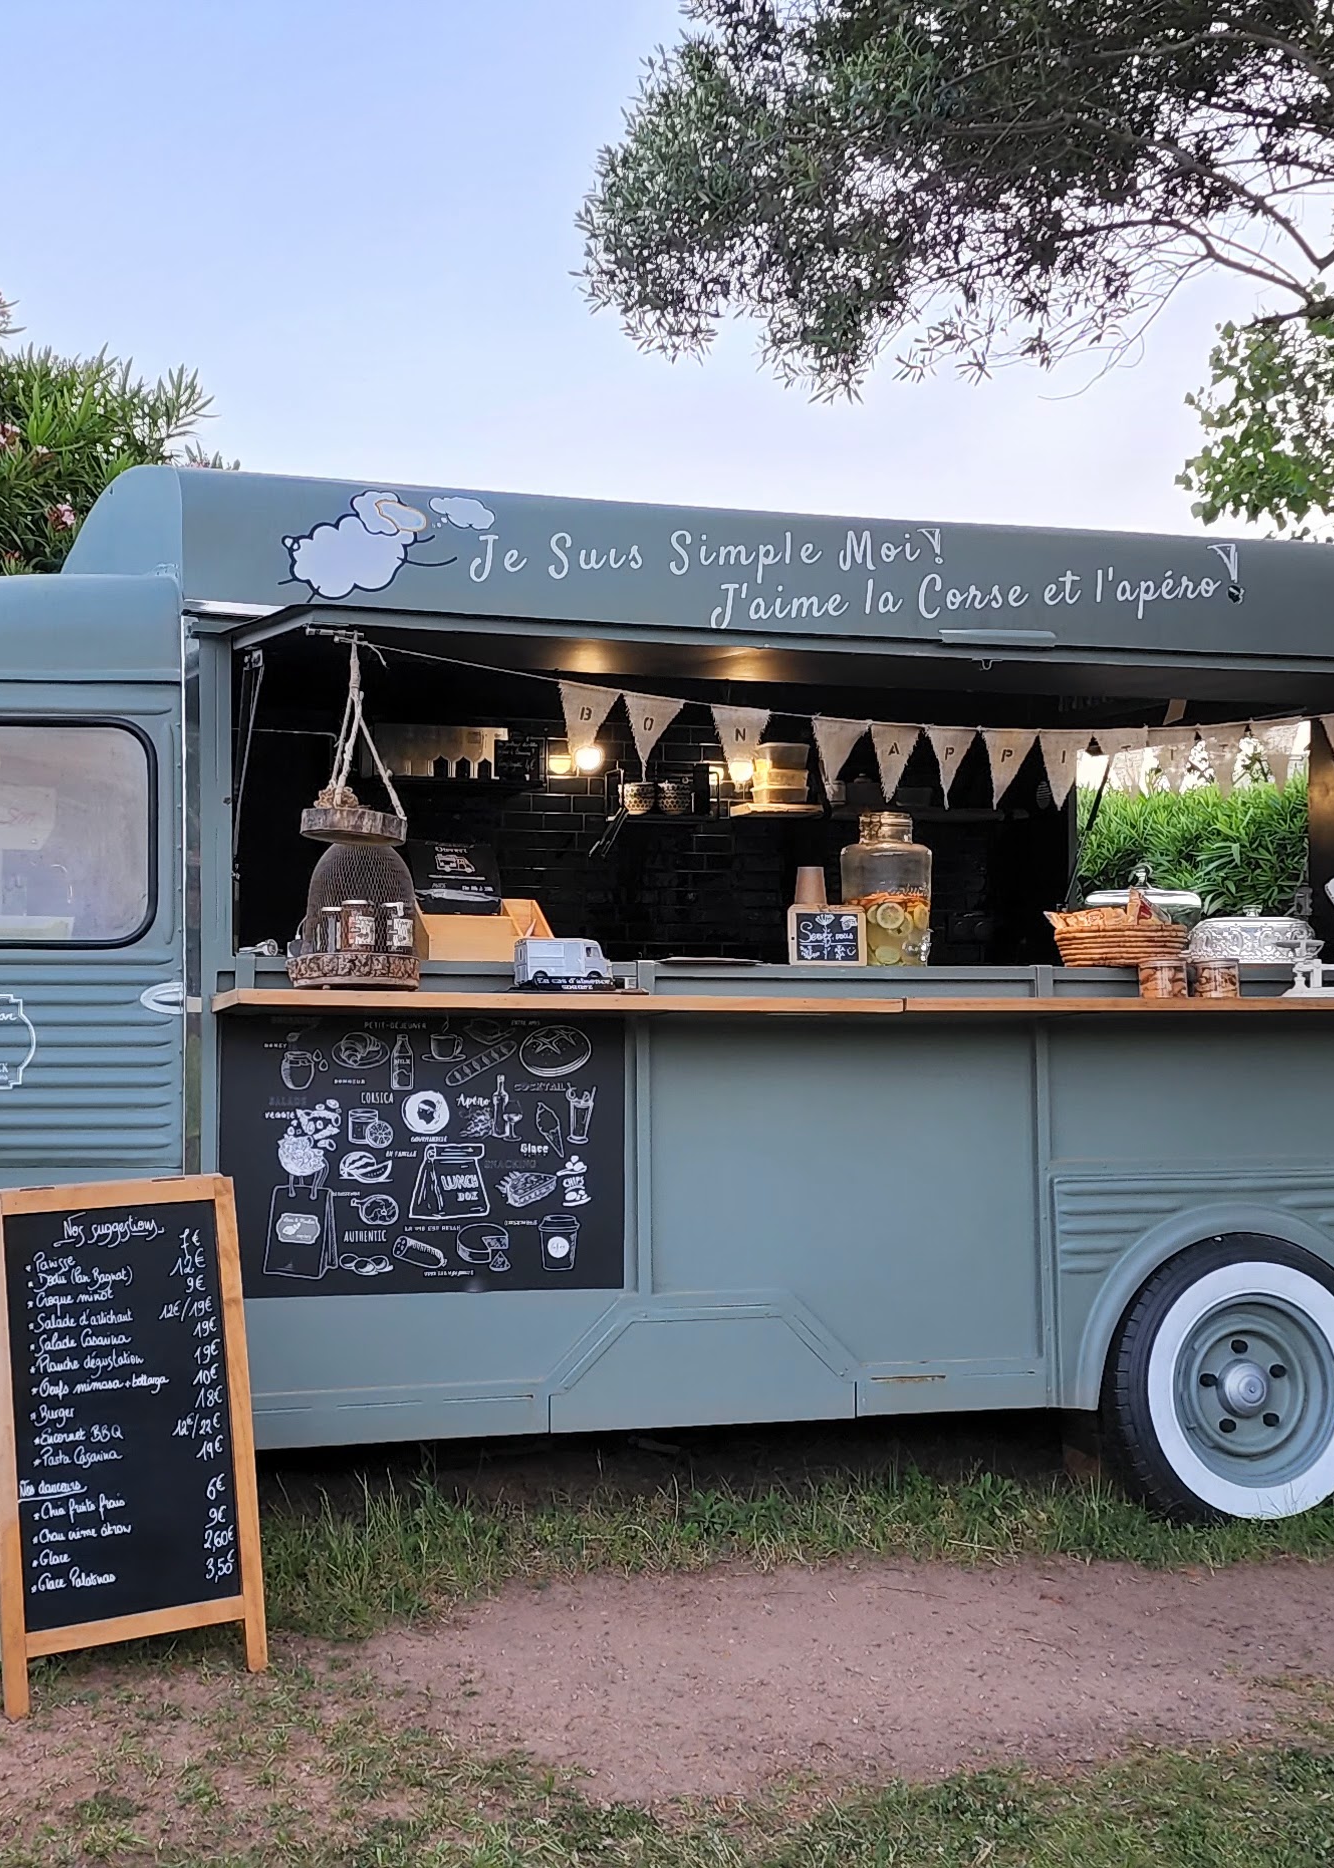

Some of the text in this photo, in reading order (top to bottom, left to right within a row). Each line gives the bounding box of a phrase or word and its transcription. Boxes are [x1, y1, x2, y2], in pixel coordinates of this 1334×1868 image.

[468, 533, 527, 582] Je
[547, 532, 643, 579] Suis
[669, 530, 822, 584] Simple
[710, 582, 849, 630] J'aime
[864, 578, 904, 615] la
[917, 573, 1029, 619] Corse
[1042, 569, 1081, 605] et
[360, 1091, 394, 1104] CORSICA
[440, 1173, 479, 1191] LUNCH
[562, 1176, 585, 1189] CHIPS
[457, 1191, 479, 1201] BOX
[63, 1212, 159, 1248] Nos suggestions
[343, 1230, 387, 1243] AUTHENTIC
[33, 1251, 77, 1274] Panisse
[169, 1248, 206, 1276] 12€
[185, 1274, 207, 1293] 9€
[36, 1292, 75, 1316] Croque
[34, 1308, 134, 1332] Salade d'artichaut
[192, 1316, 218, 1338] 19€
[34, 1332, 77, 1357] Salade
[193, 1338, 221, 1365] 19€
[36, 1348, 145, 1379] Planche dégustation
[192, 1363, 219, 1385] 10€
[72, 1379, 124, 1394] mimosa
[194, 1385, 223, 1409] 18€
[34, 1404, 75, 1428] Burger
[90, 1424, 125, 1442] BBQ
[40, 1446, 72, 1467] Pasta
[206, 1473, 226, 1500] 6€
[98, 1493, 126, 1521] frais
[205, 1505, 227, 1528] 9€
[39, 1548, 72, 1566] Glace
[38, 1573, 68, 1592] Glace
